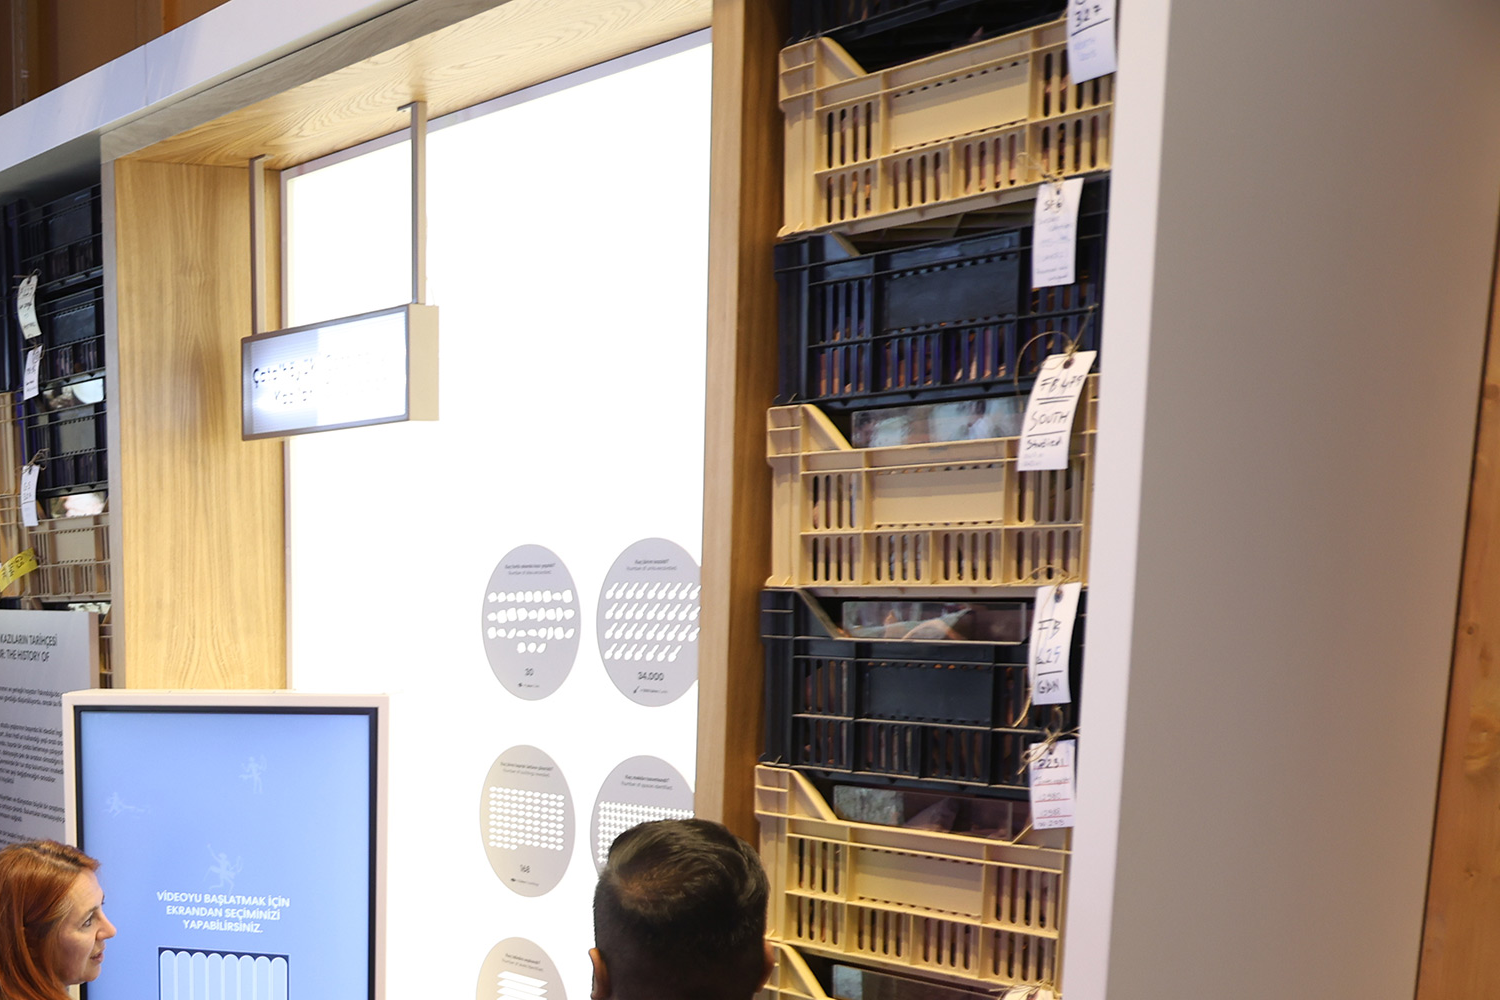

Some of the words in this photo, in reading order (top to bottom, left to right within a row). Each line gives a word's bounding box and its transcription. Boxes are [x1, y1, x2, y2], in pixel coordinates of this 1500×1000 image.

[156, 890, 202, 903] VİDEOYU
[204, 893, 266, 907] BAŞLATMAK
[268, 895, 290, 909] İÇİN
[166, 905, 223, 917] EKRANDAN
[224, 907, 280, 921] SEÇİMİNİZİ
[182, 919, 263, 933] YAPABİLİRSİNİZ.
